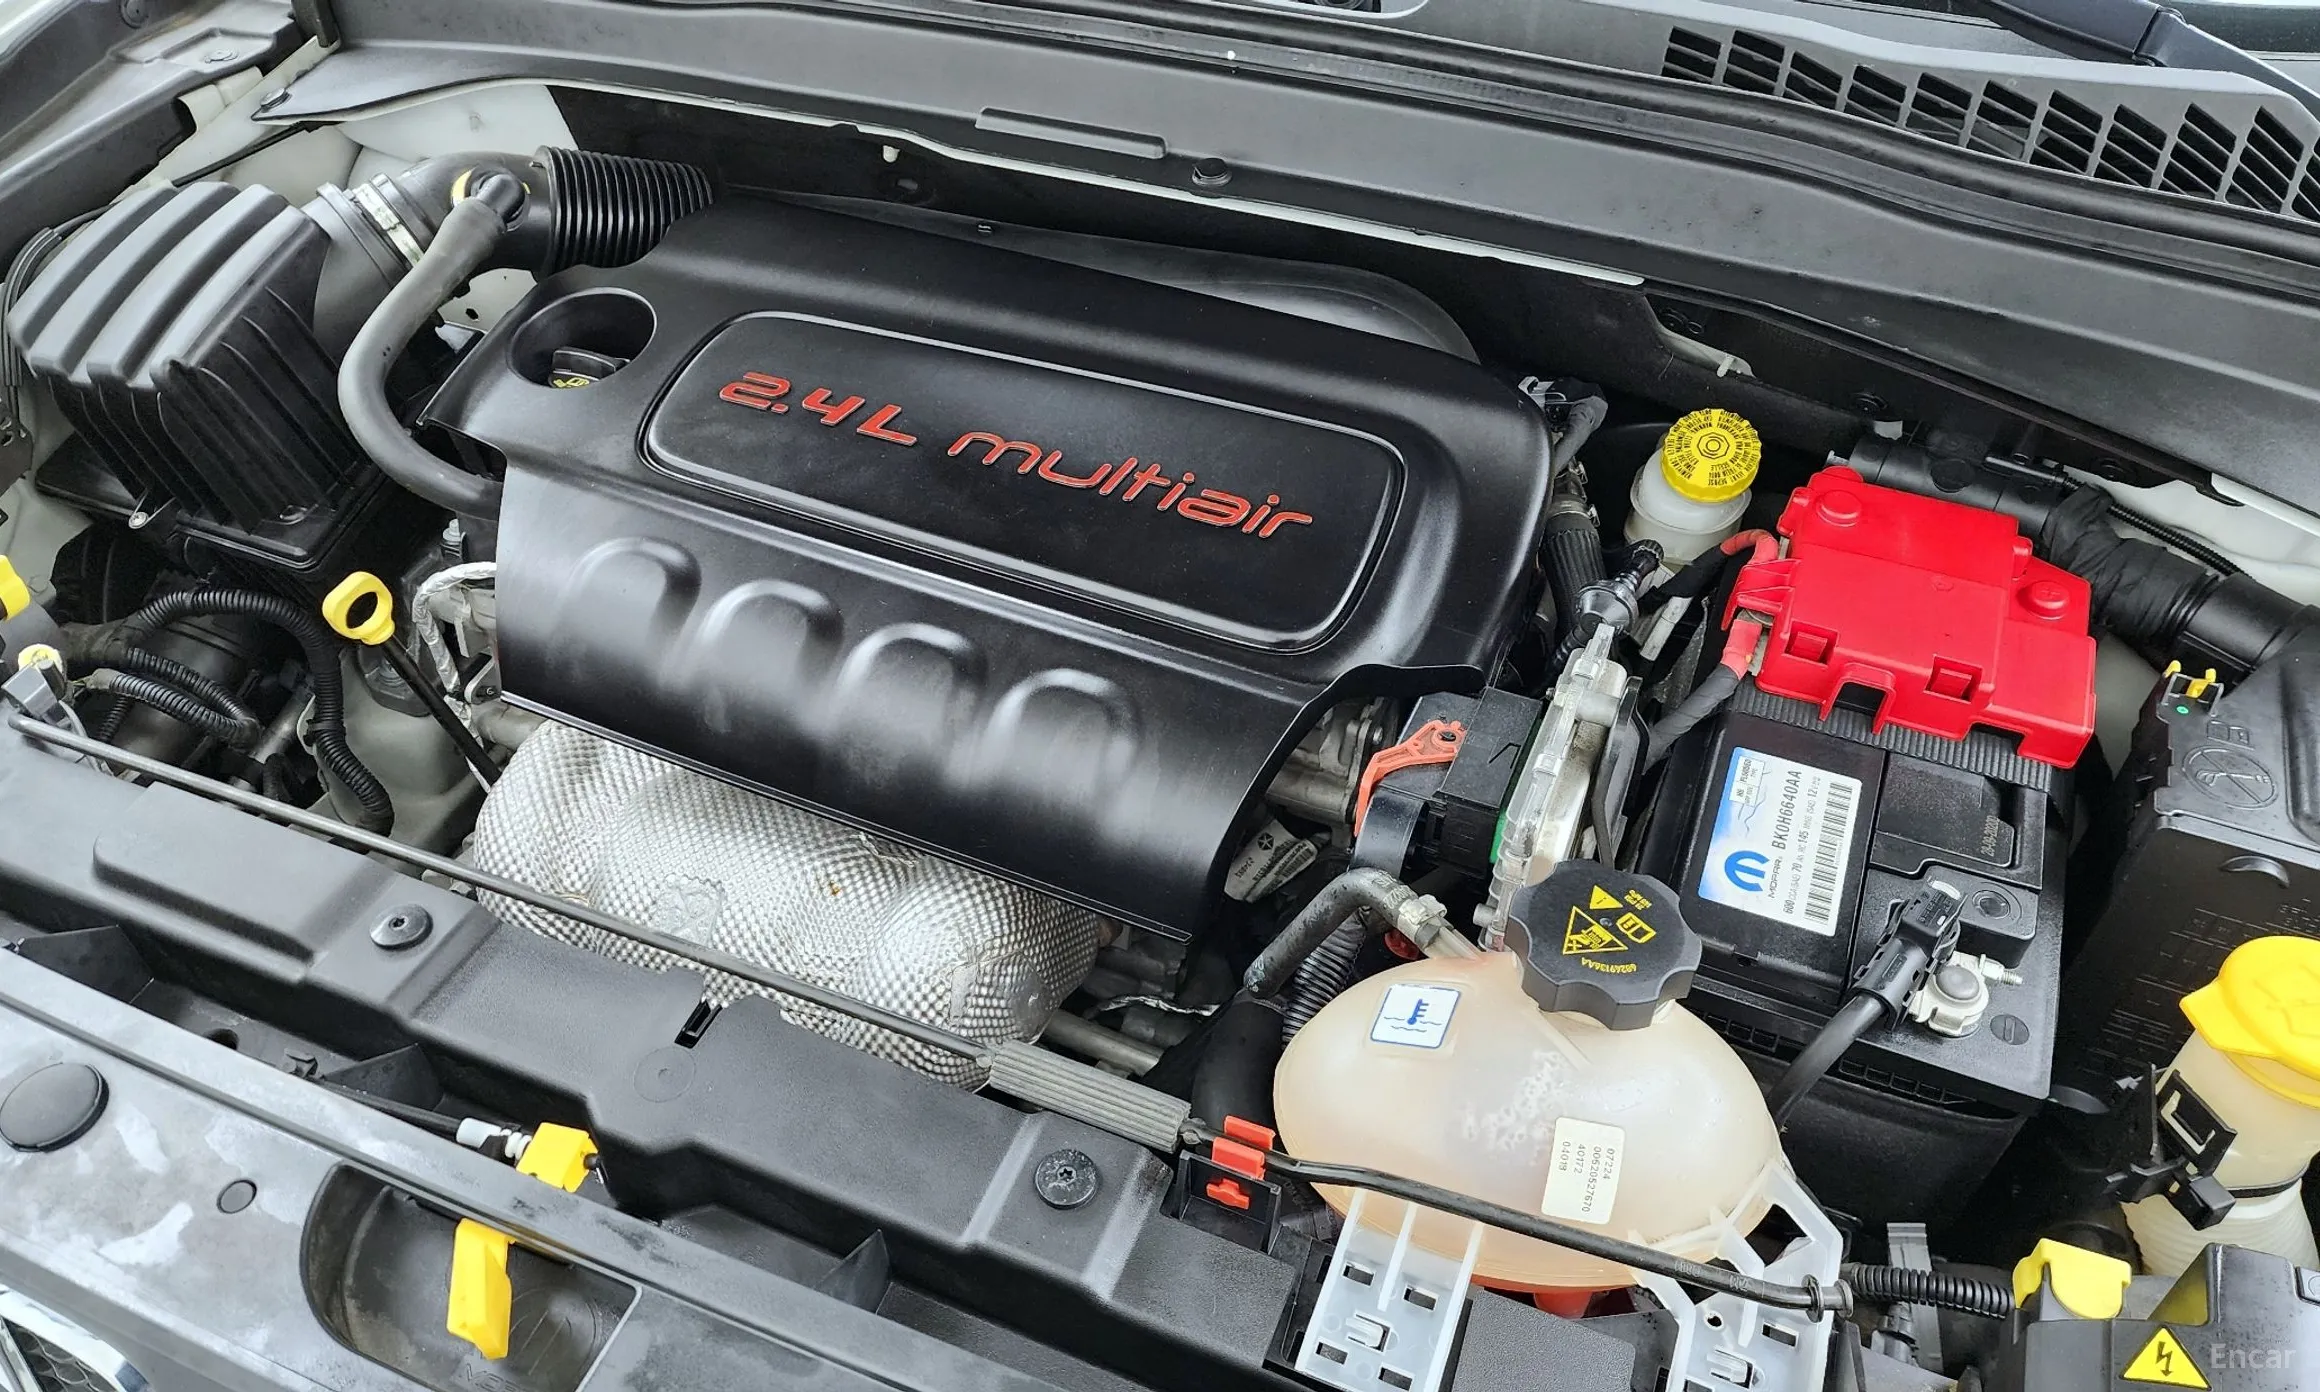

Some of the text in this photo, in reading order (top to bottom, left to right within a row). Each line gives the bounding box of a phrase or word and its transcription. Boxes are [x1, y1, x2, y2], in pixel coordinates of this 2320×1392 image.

[719, 371, 1313, 539] 2.4L multiair
[1768, 859, 1782, 898] MOPAR
